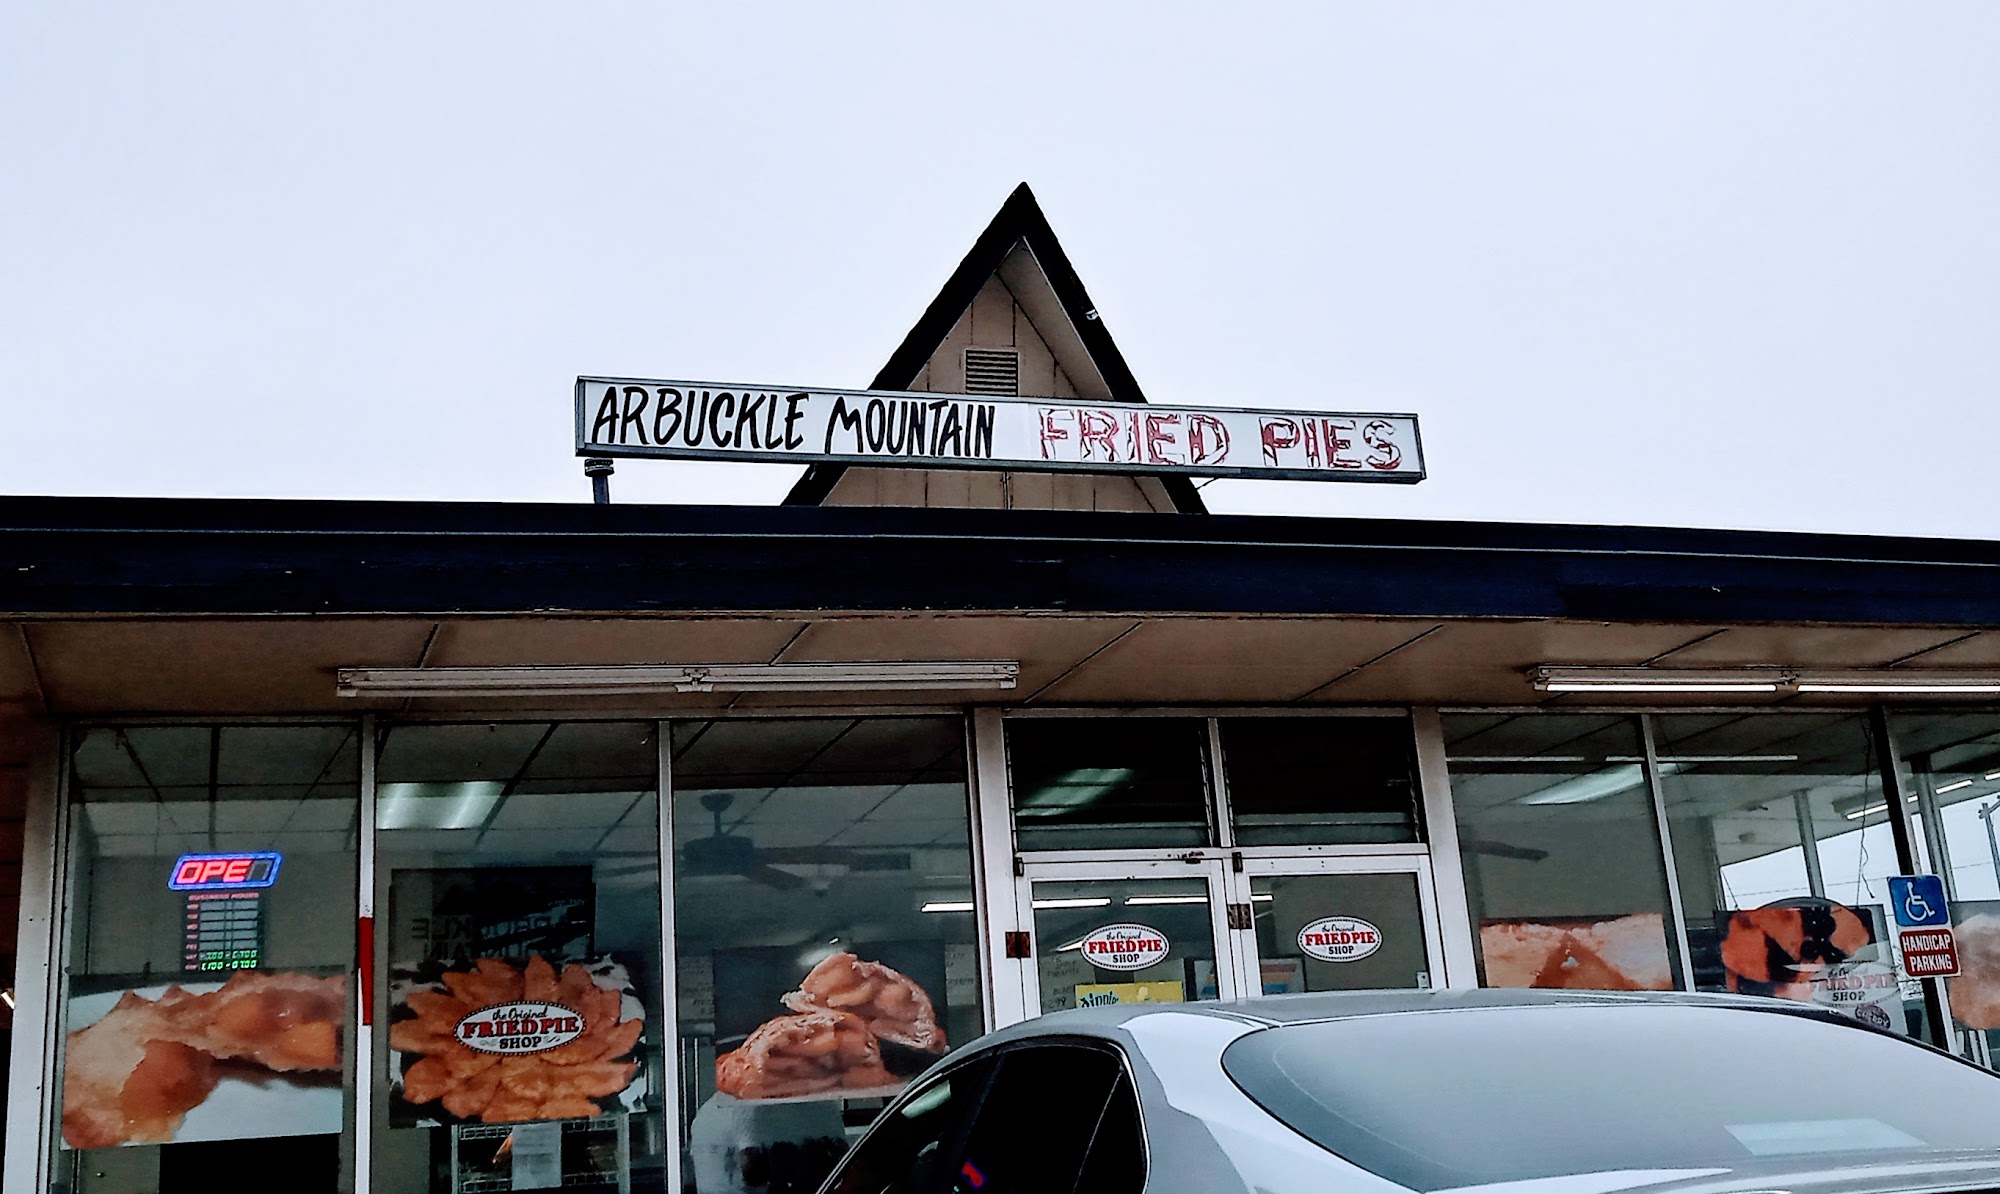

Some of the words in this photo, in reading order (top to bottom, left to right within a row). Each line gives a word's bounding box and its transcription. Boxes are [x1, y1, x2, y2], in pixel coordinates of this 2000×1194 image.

[591, 386, 808, 450] ARBUCKLE
[825, 395, 995, 459] MOUNTAIN
[1038, 407, 1230, 466] FRIED
[1259, 416, 1402, 470] PIES
[1328, 945, 1355, 955] SHOP
[1901, 934, 1951, 952] HANDICAP
[1112, 954, 1140, 963] SHOP
[1909, 954, 1953, 972] PARKING
[1832, 990, 1866, 1001] SHOP
[492, 1008, 507, 1020] the
[508, 1005, 548, 1021] Original
[499, 1036, 541, 1049] SHOP
